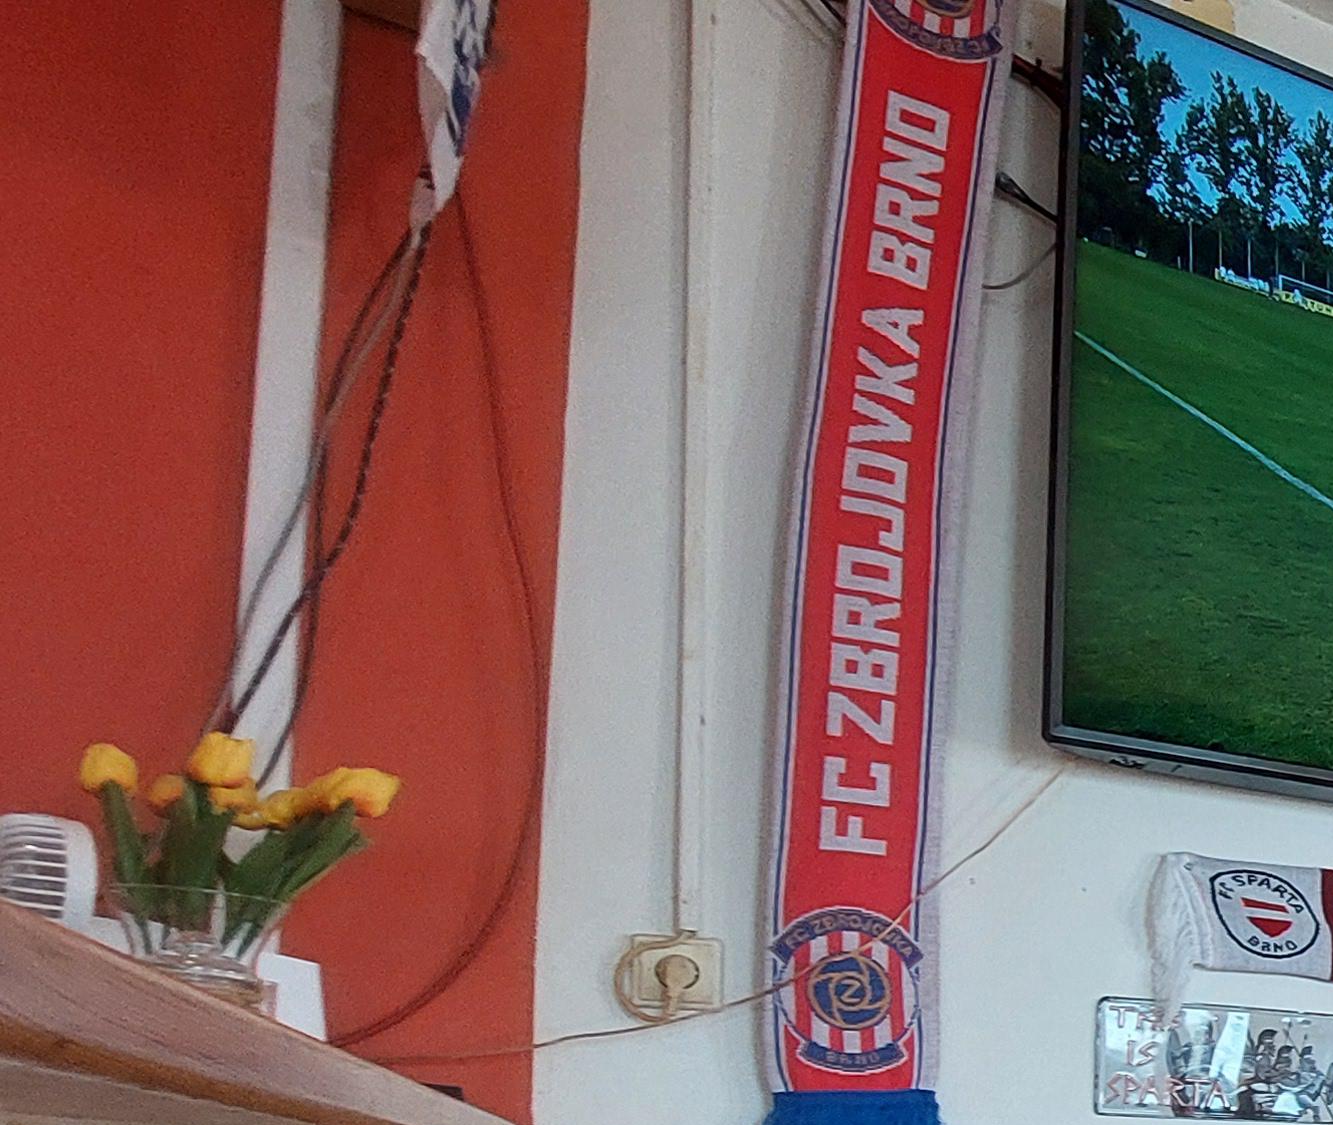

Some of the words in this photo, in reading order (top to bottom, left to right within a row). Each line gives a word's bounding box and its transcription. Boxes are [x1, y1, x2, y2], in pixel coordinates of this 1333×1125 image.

[866, 90, 951, 291] BRNO
[825, 306, 925, 746] ZBROJOVKA
[818, 755, 892, 857] FC
[1230, 874, 1305, 914] SPARTA
[1247, 935, 1298, 953] BRNO
[1103, 1071, 1231, 1108] SPARTA
